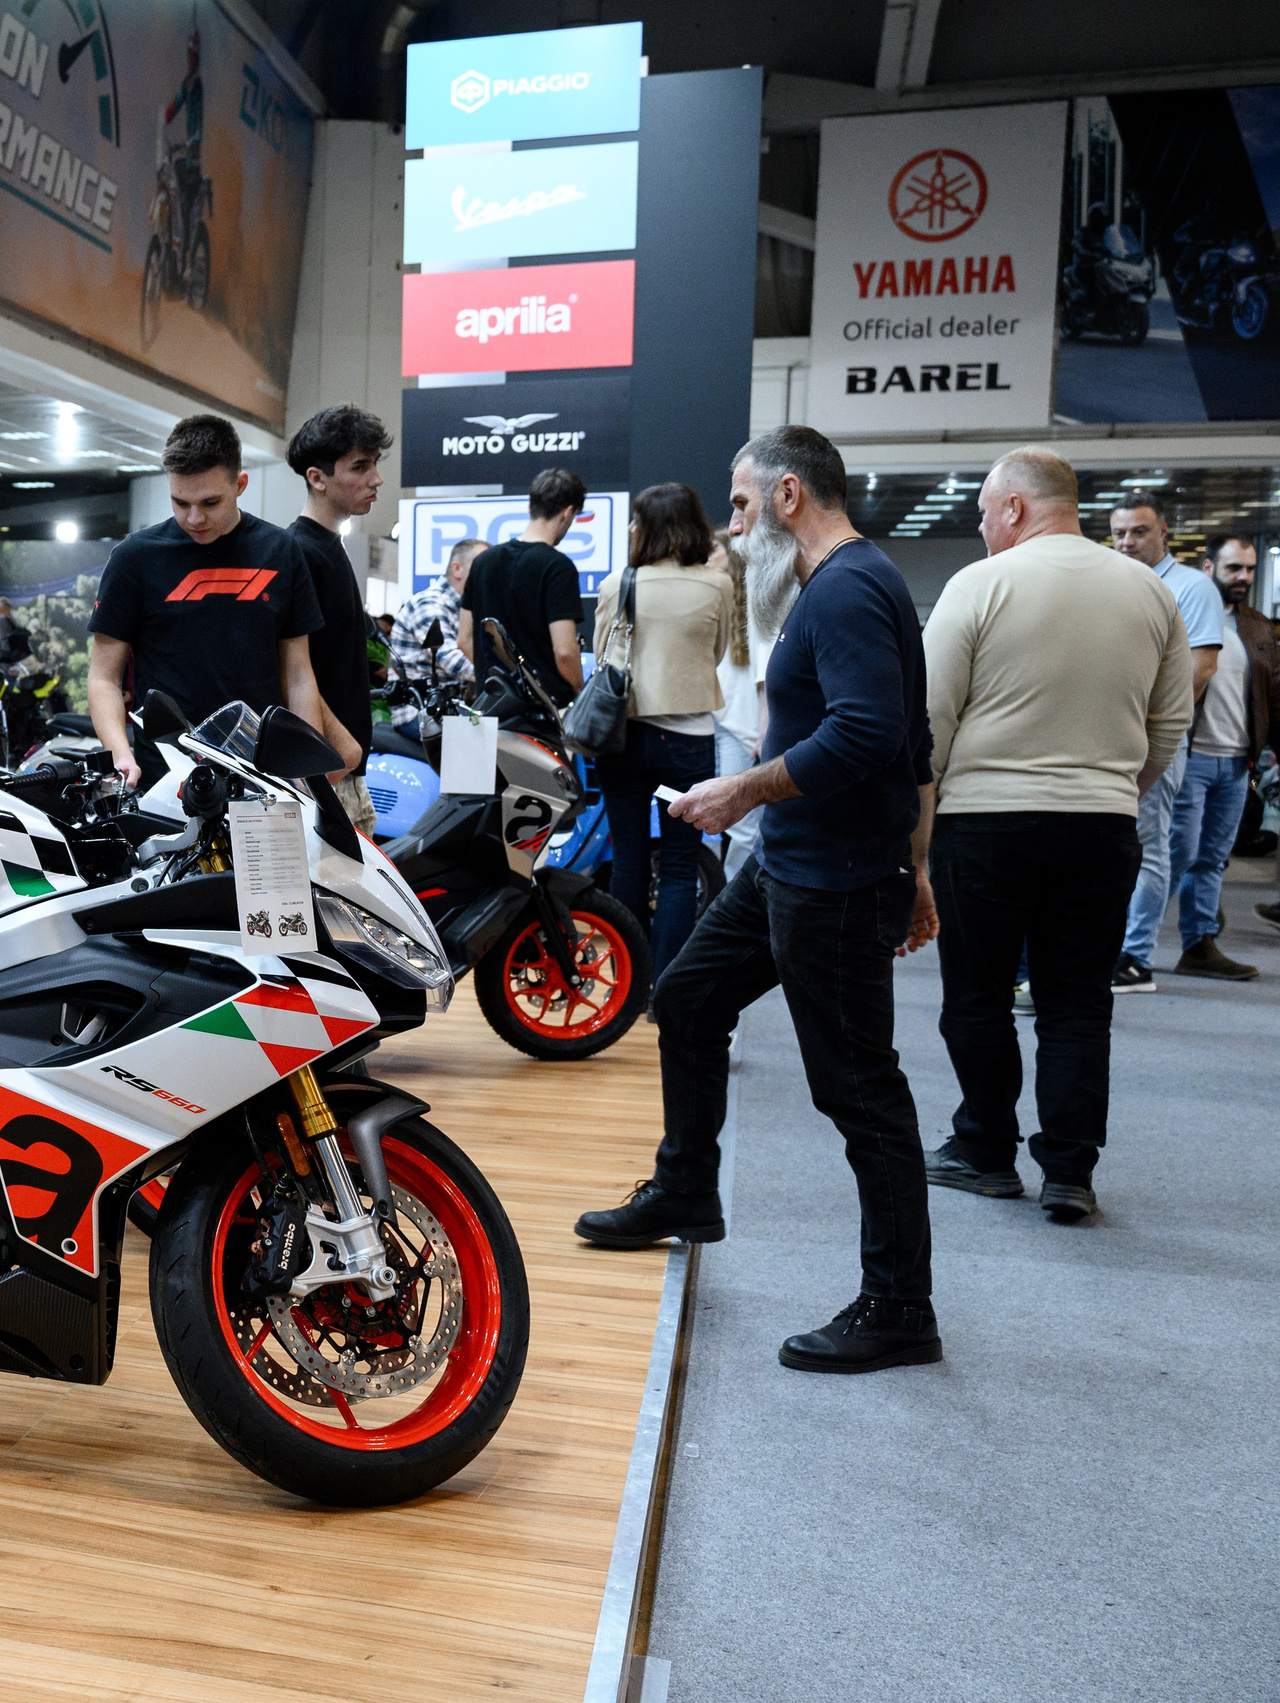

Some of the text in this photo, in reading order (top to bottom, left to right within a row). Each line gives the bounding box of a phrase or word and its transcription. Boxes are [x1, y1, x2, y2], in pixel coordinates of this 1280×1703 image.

[493, 72, 590, 97] PIAGGIO
[451, 184, 588, 233] Vespa
[853, 254, 1016, 299] YAMAHA
[455, 295, 571, 344] aprilia
[843, 313, 1020, 341] Official dealer
[846, 362, 1011, 394] BAREL
[442, 432, 579, 456] MOTO GUZZI
[278, 1222, 296, 1270] brembo
